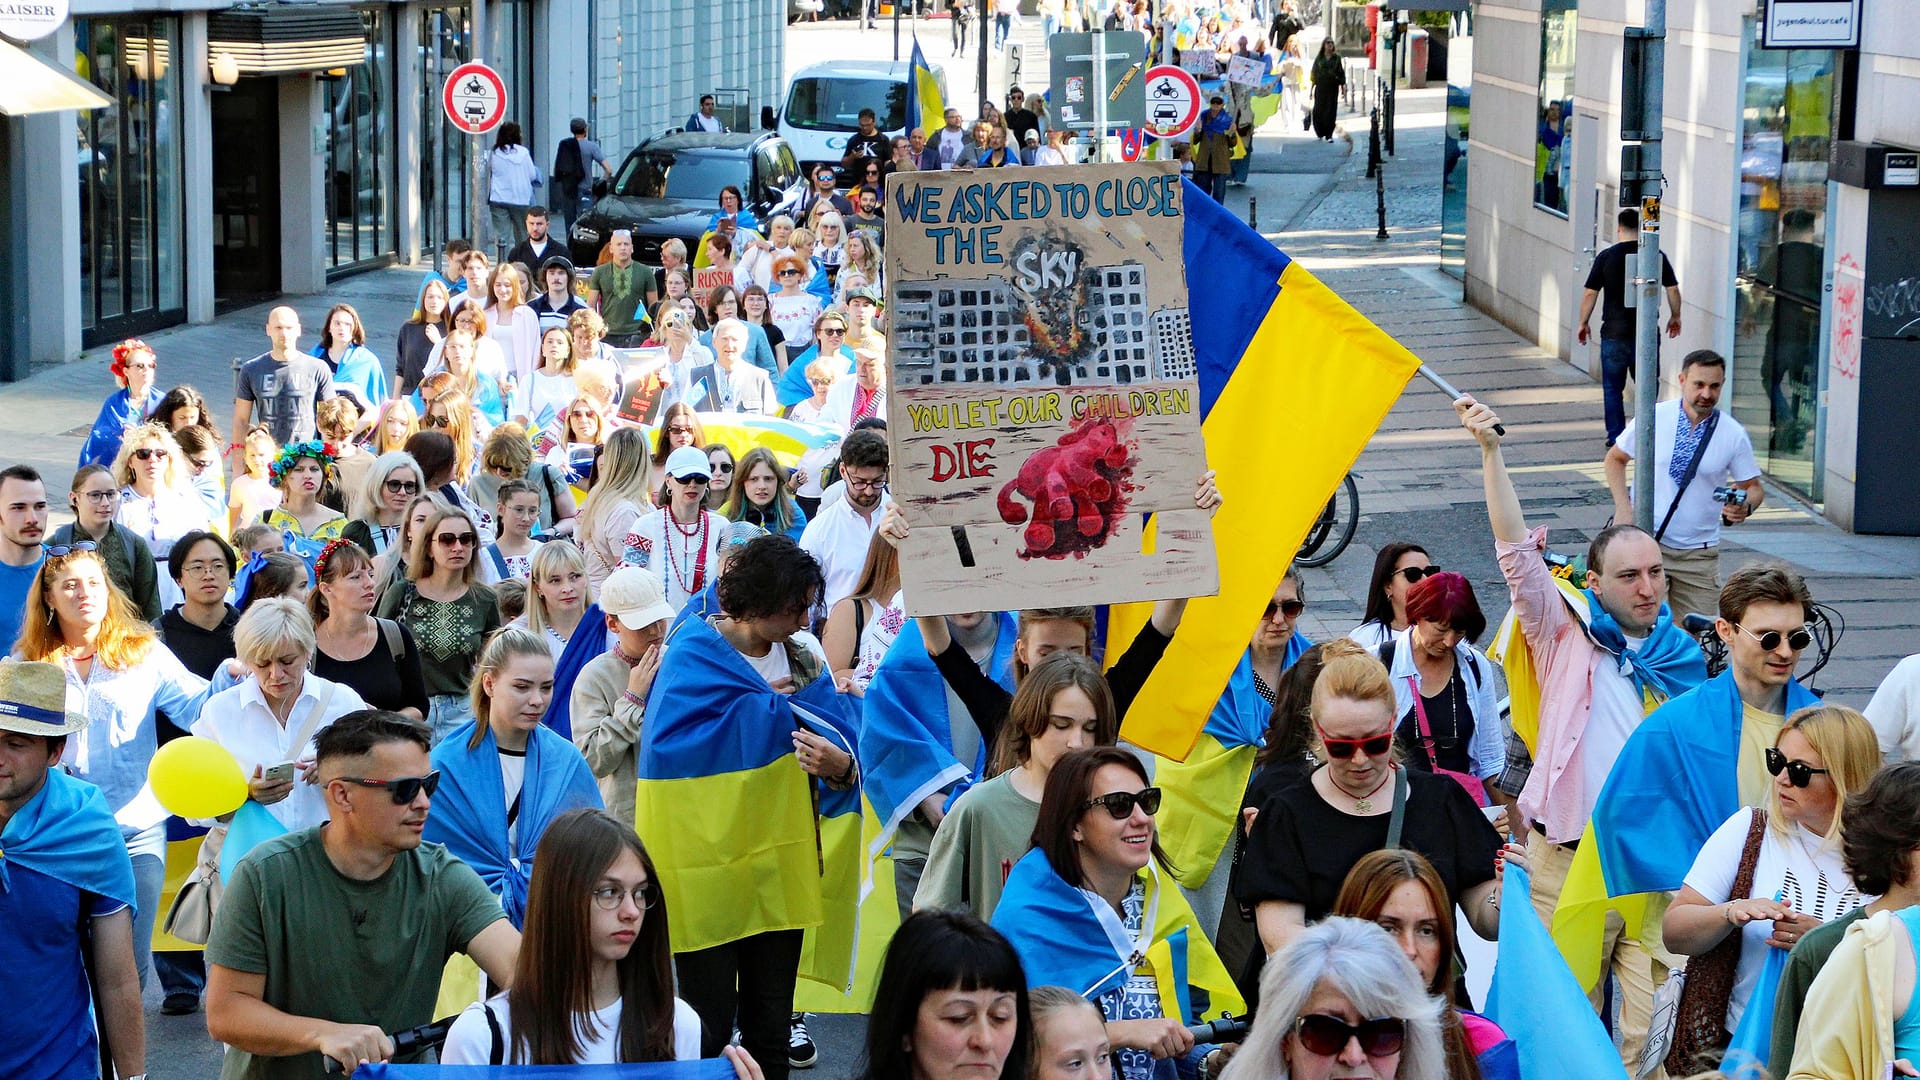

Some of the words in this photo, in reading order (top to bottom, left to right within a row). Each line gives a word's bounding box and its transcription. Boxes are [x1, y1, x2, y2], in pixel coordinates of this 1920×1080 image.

[895, 182, 943, 224] WE
[947, 181, 1052, 224] ASKED
[1053, 182, 1090, 219] TO
[1095, 175, 1180, 218] CLOSE
[925, 225, 1004, 265] THE
[697, 271, 734, 288] RUSSIA
[1016, 251, 1077, 293] SKY
[907, 404, 950, 432] YOU
[951, 397, 1002, 430] LET
[1008, 392, 1063, 425] OUR
[1071, 389, 1190, 420] CHILDREN
[928, 438, 998, 483] DIE
